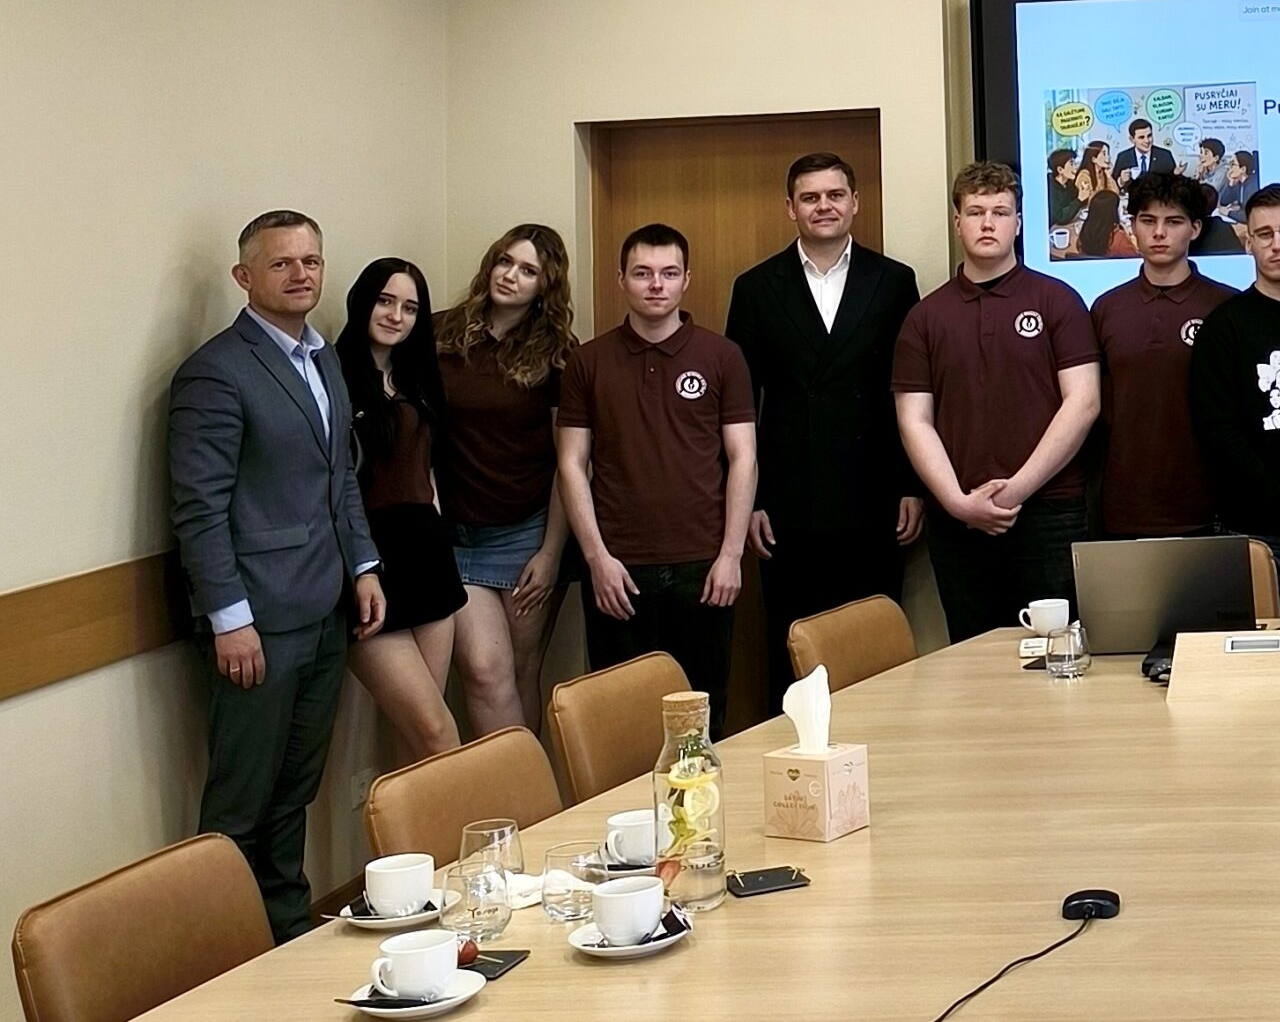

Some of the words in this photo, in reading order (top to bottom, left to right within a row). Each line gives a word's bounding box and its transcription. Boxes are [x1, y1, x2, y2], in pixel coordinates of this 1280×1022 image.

[1243, 6, 1260, 14] Join
[1261, 5, 1270, 13] at
[1195, 88, 1238, 100] PUSRYČIAI
[1197, 103, 1207, 112] SU
[1209, 98, 1241, 110] MERU!
